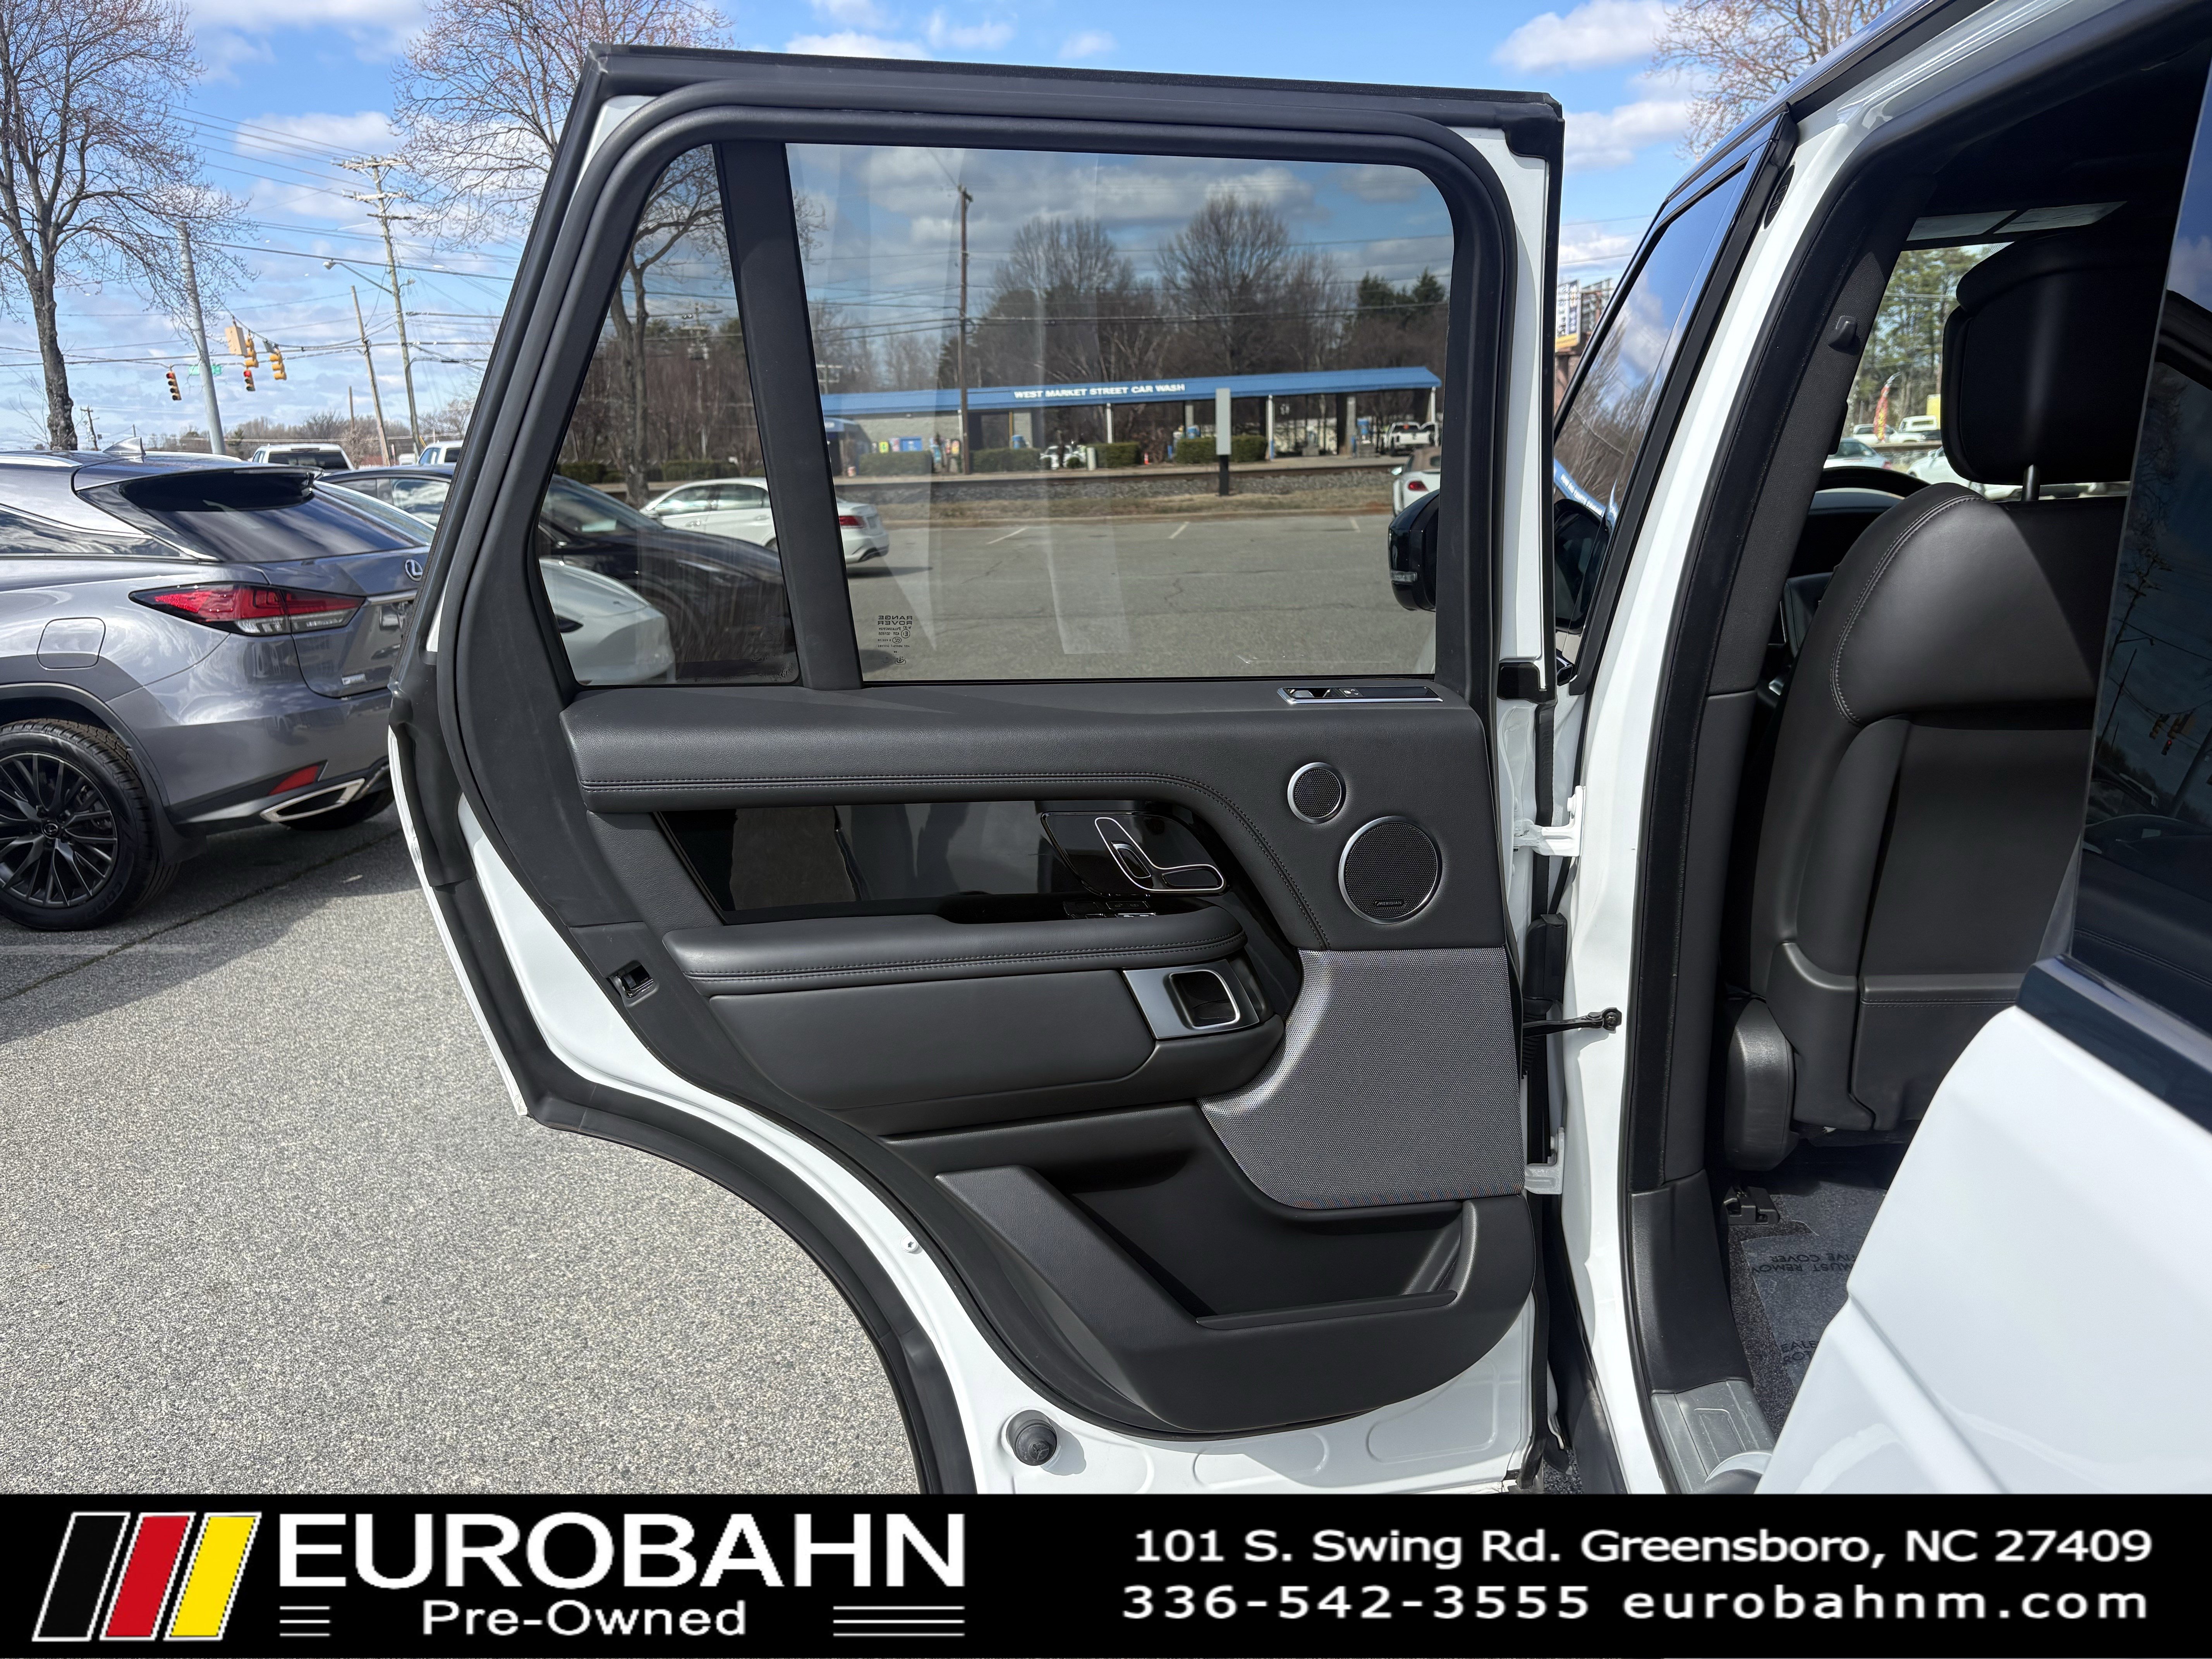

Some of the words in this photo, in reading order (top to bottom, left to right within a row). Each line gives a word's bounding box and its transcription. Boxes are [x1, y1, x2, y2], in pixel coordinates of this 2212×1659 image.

[1014, 390, 1042, 398] WEST
[1045, 389, 1087, 397] MARKET
[1089, 387, 1128, 395] STREET
[1131, 385, 1153, 393] CAR
[1155, 384, 1185, 392] WASH
